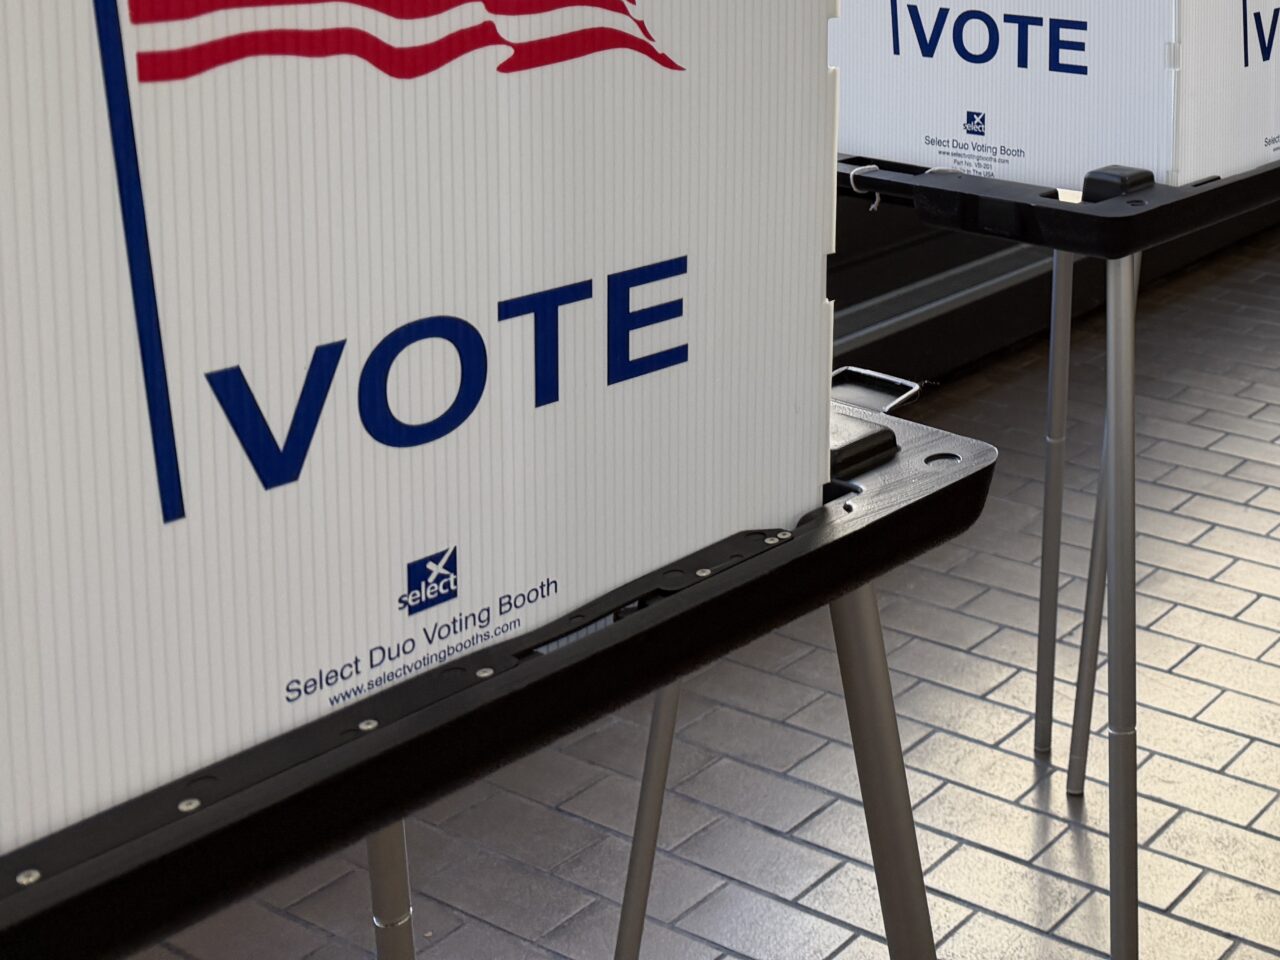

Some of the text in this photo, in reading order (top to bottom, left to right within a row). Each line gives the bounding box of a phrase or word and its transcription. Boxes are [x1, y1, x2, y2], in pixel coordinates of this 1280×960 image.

[906, 4, 1089, 75] VOTE
[924, 135, 1025, 158] Select Duo Voting Booth
[204, 254, 689, 490] VOTE
[398, 572, 458, 610] select
[285, 578, 558, 703] Select Duo Voting Booth
[329, 618, 521, 706] www.selectvotingbooths.com
